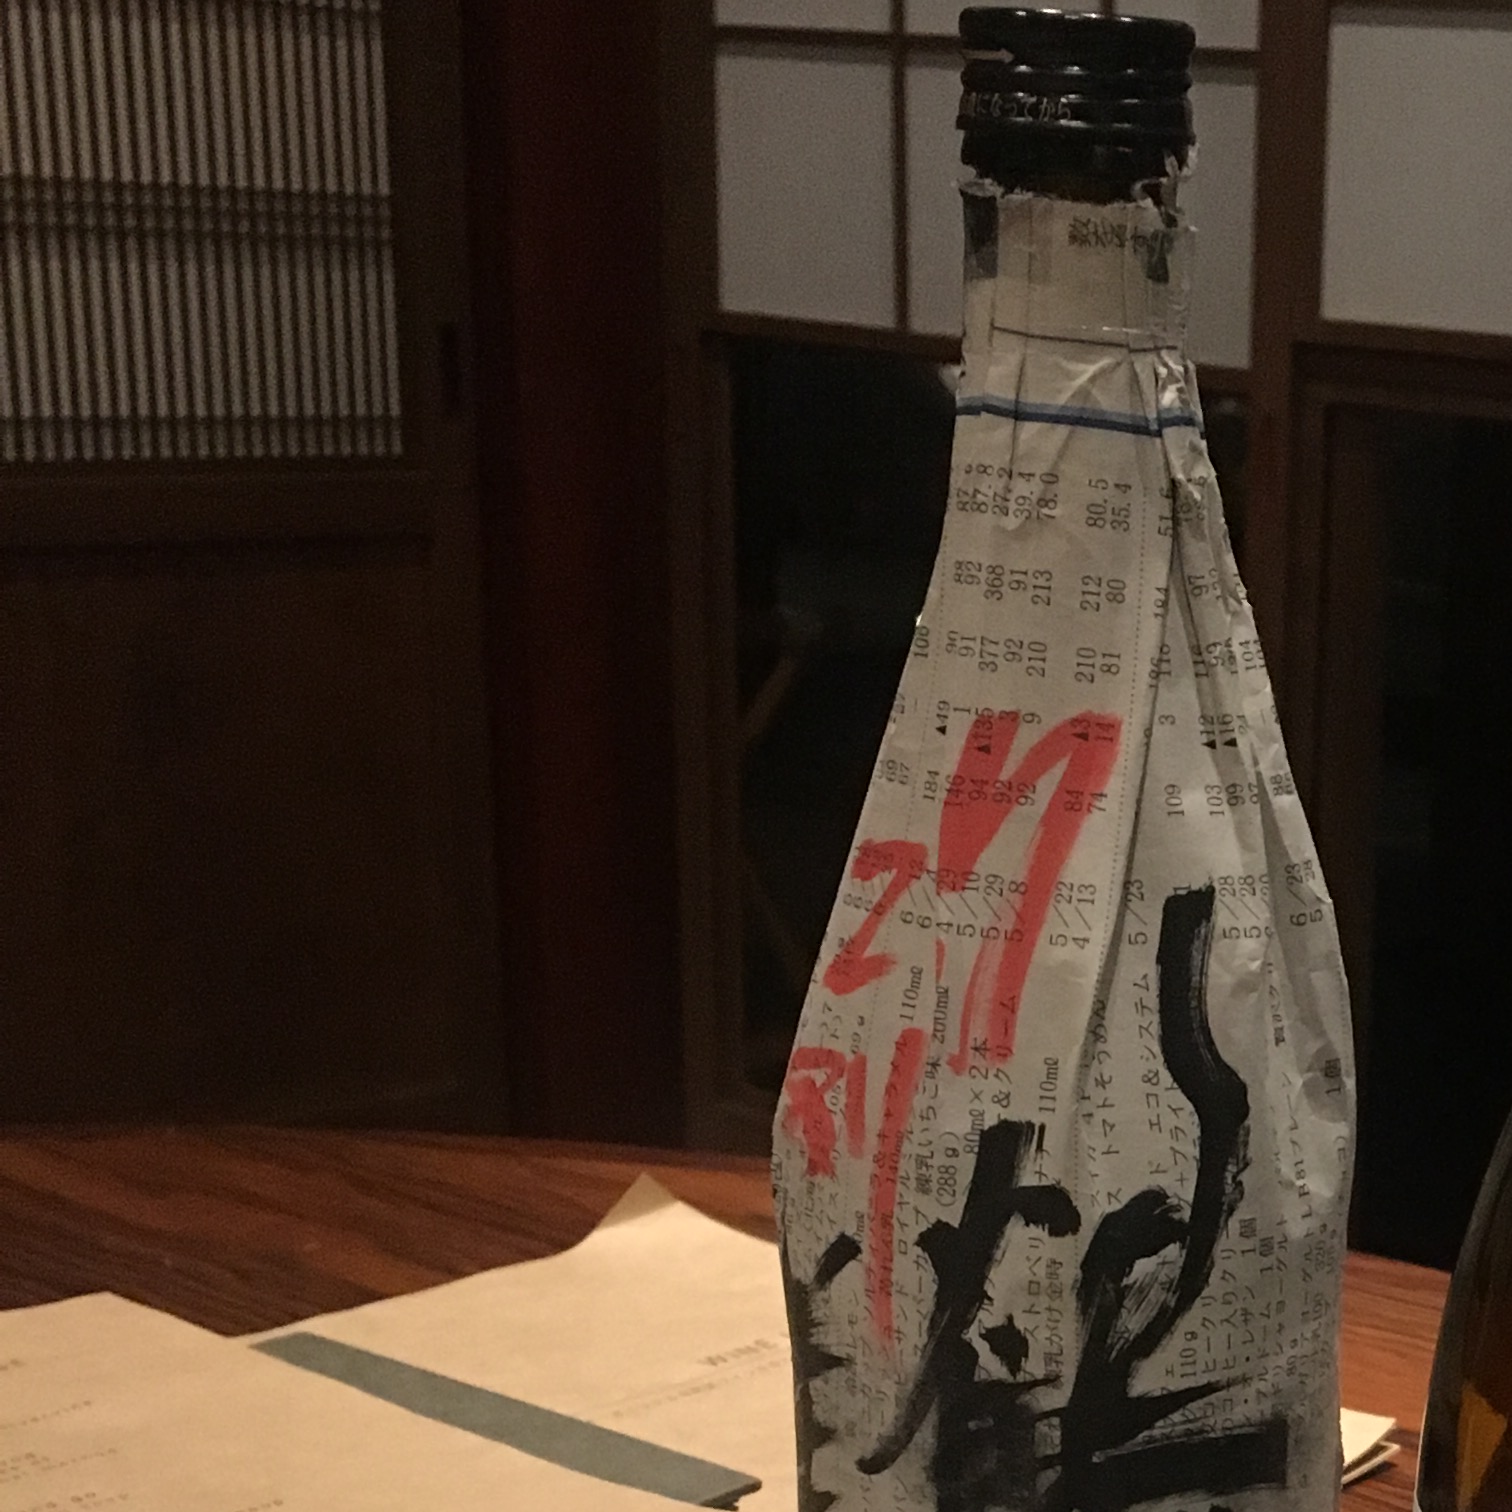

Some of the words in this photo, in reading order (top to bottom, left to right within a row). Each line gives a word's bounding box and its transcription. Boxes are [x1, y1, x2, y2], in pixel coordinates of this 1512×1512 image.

[1086, 478, 1109, 529] 80.5
[1111, 482, 1132, 532] 35.4
[985, 563, 1006, 601] 368
[1009, 567, 1028, 591] 91
[1032, 569, 1053, 606] 213
[1080, 574, 1102, 612] 212
[1106, 577, 1126, 604] 80
[979, 636, 1000, 673] 377
[1004, 637, 1023, 662] 92
[1028, 641, 1048, 678] 210
[1075, 646, 1096, 684] 210
[1101, 650, 1121, 675] 81
[1165, 784, 1184, 817] 109
